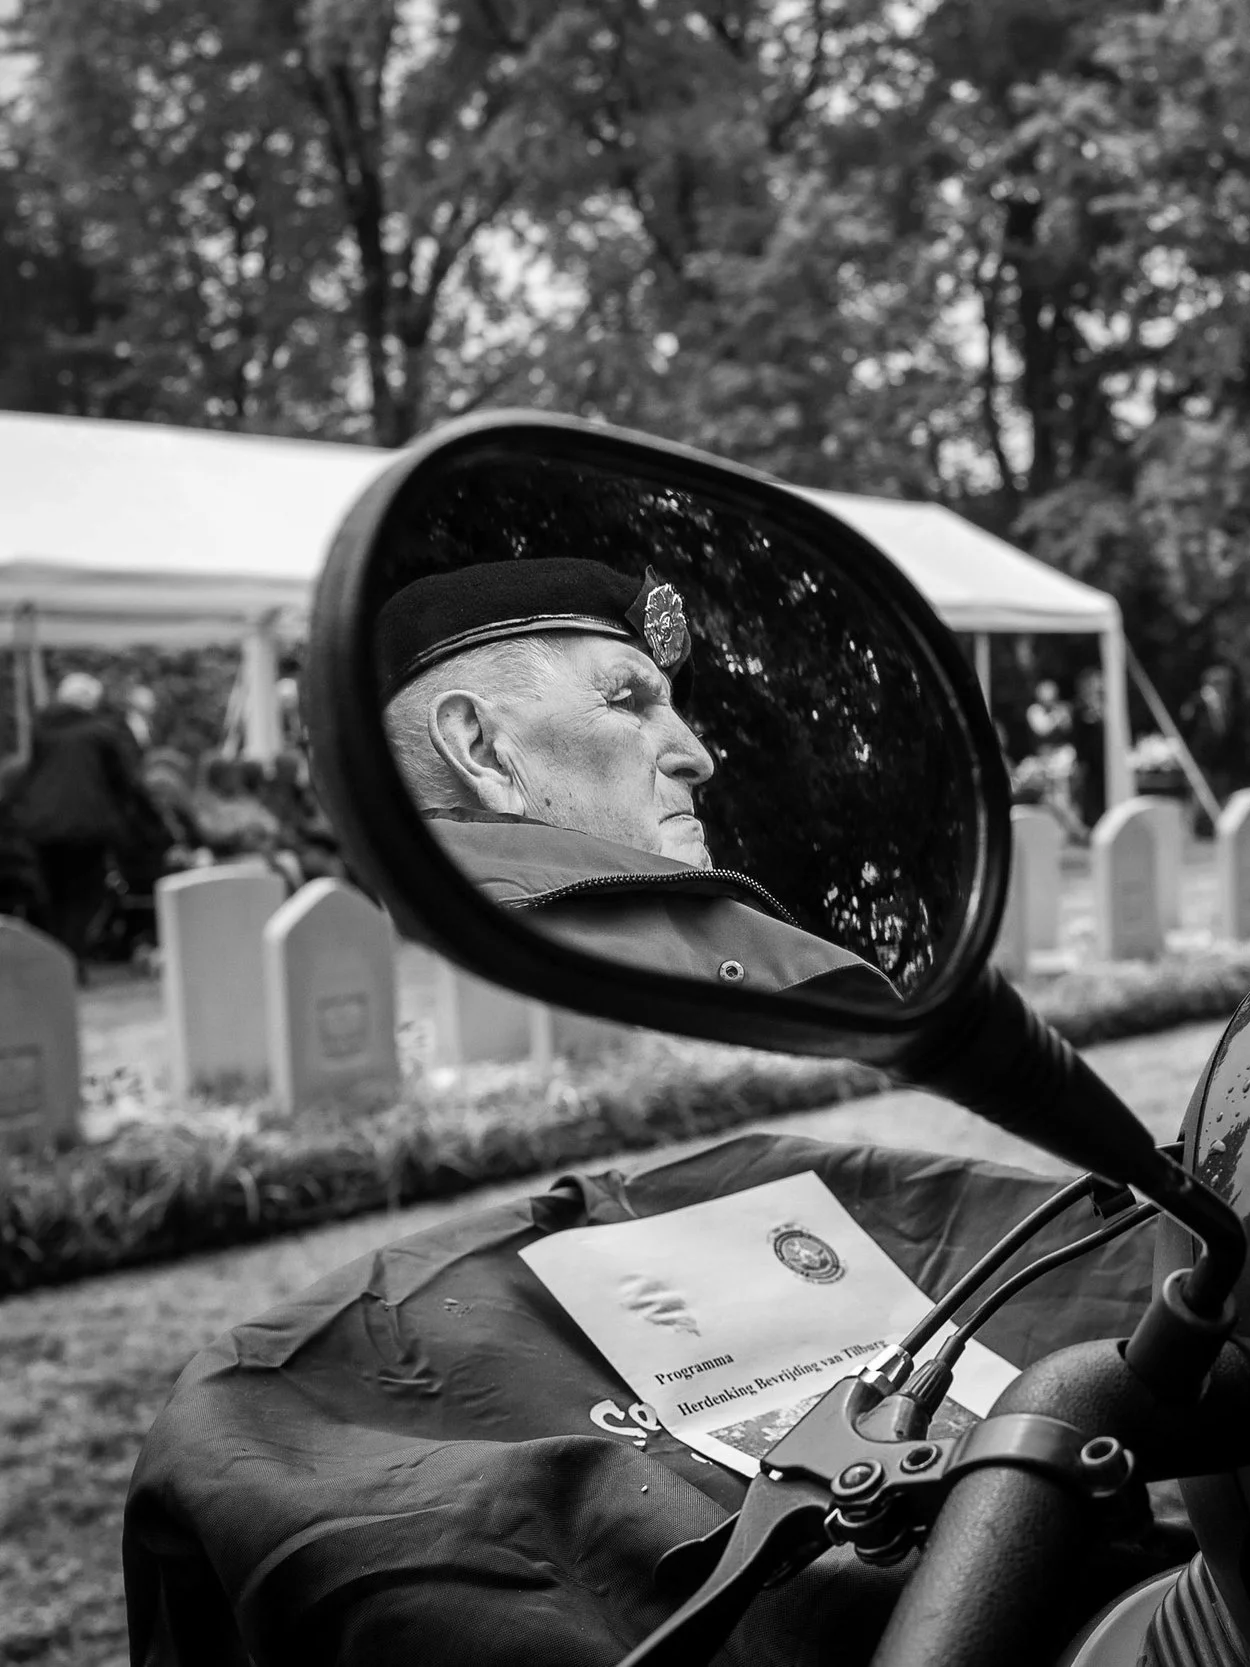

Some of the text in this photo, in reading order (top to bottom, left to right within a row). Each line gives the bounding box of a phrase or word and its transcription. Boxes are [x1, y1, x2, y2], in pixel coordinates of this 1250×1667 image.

[655, 1353, 734, 1386] Programma
[677, 1339, 889, 1416] Herdenking Bevrijding van Tilburg
